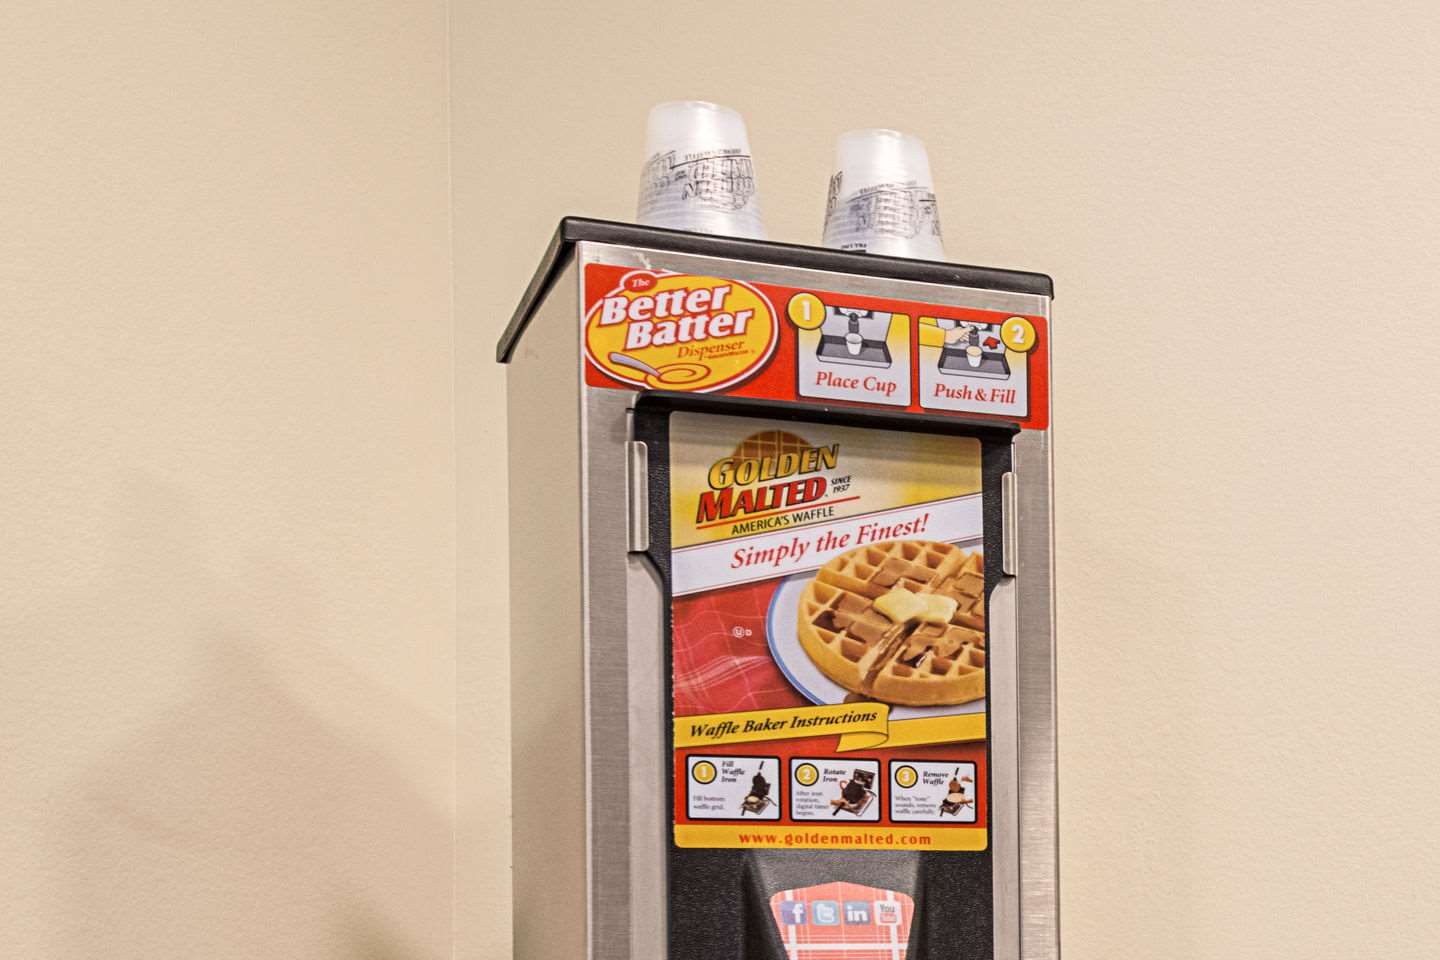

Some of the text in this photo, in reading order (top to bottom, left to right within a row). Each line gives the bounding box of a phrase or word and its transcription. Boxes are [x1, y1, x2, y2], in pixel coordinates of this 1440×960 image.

[631, 279, 651, 288] The
[597, 284, 733, 327] Better
[801, 301, 811, 321] 1
[622, 309, 755, 350] Batter
[1011, 324, 1025, 344] 2
[677, 341, 745, 360] Dispenser
[816, 371, 897, 397] Place Cup
[934, 384, 1017, 404] Push & Fill
[707, 444, 839, 490] GOLDEN
[696, 476, 827, 523] MALTED
[731, 506, 835, 535] AMERICA'S WAFFLE
[730, 513, 930, 569] Simply the Finest!
[690, 711, 878, 739] Waffle Baker Instructions
[739, 832, 932, 846] www.goldenmalted.com
